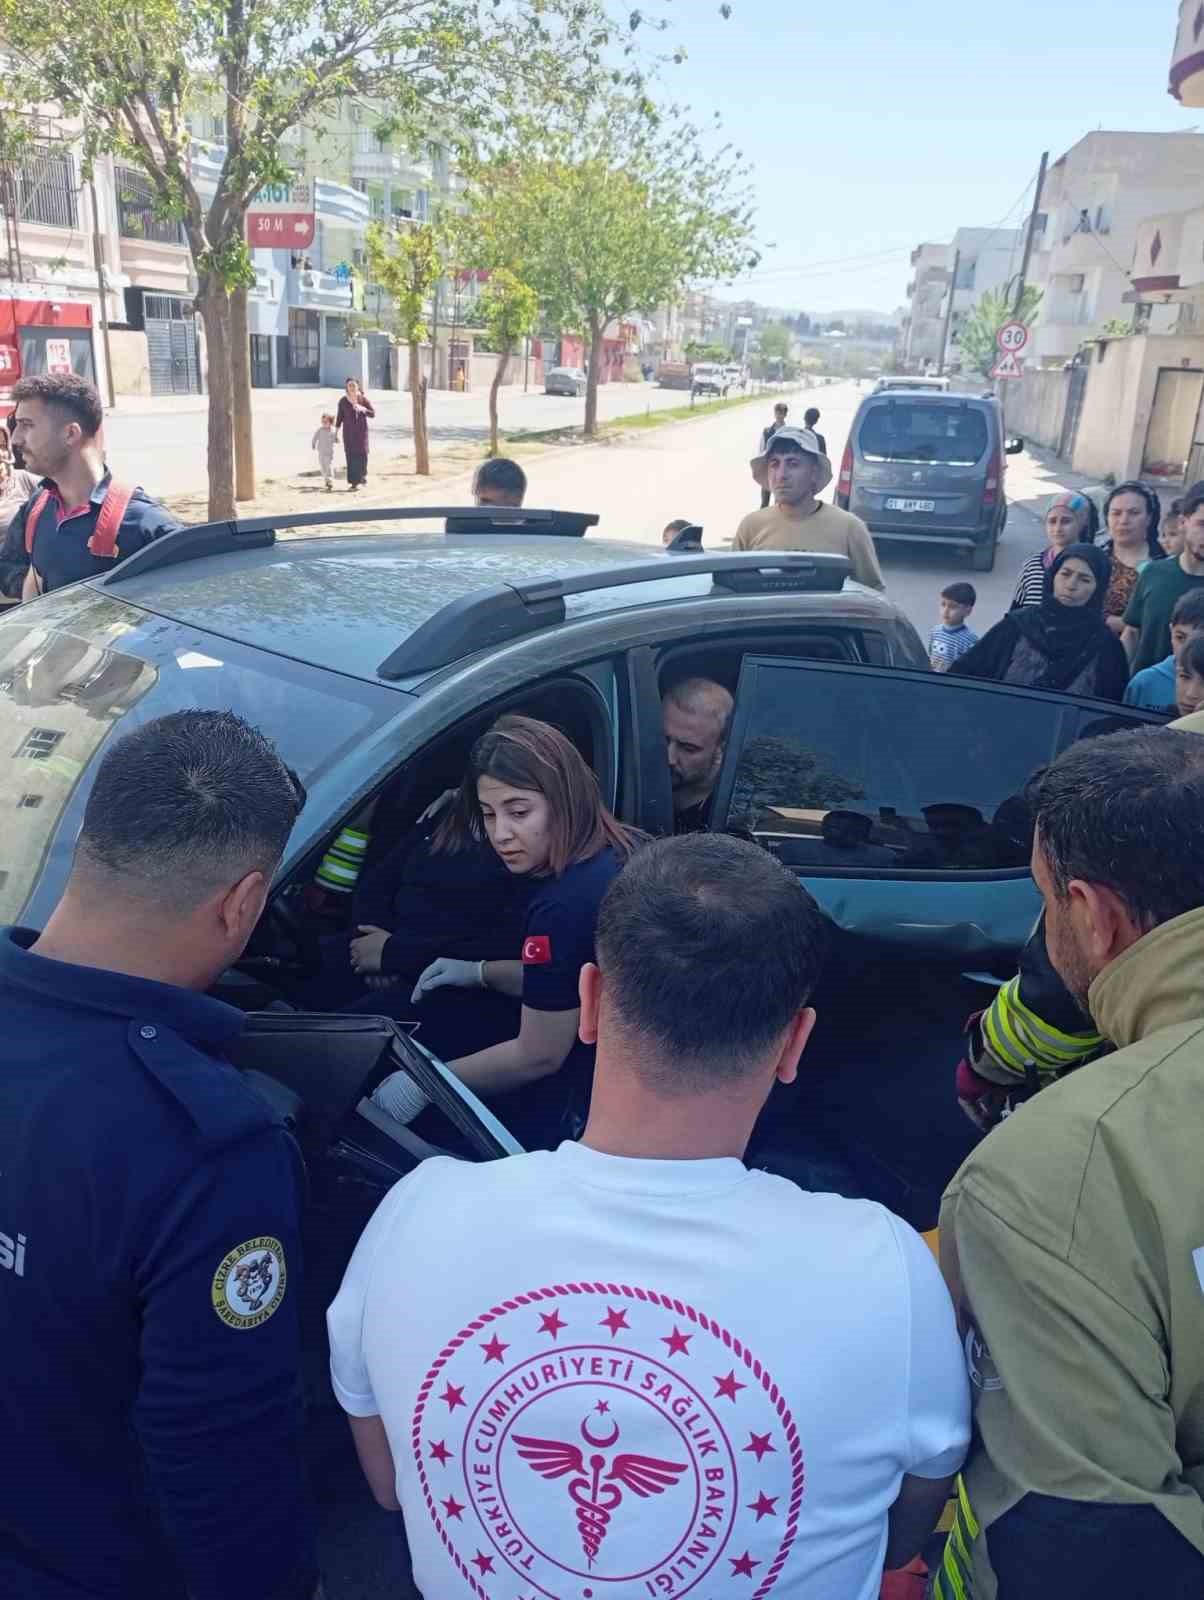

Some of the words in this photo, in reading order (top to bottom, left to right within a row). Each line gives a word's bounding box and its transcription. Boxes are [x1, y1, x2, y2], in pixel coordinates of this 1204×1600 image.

[273, 217, 284, 232] M
[1004, 330, 1023, 344] 30
[475, 1356, 634, 1454] CUMHURİYETİ
[640, 1371, 721, 1458] SAĞLIK
[473, 1462, 535, 1571] TÜRKİYE
[645, 1467, 726, 1599] BAKANLIĞI
